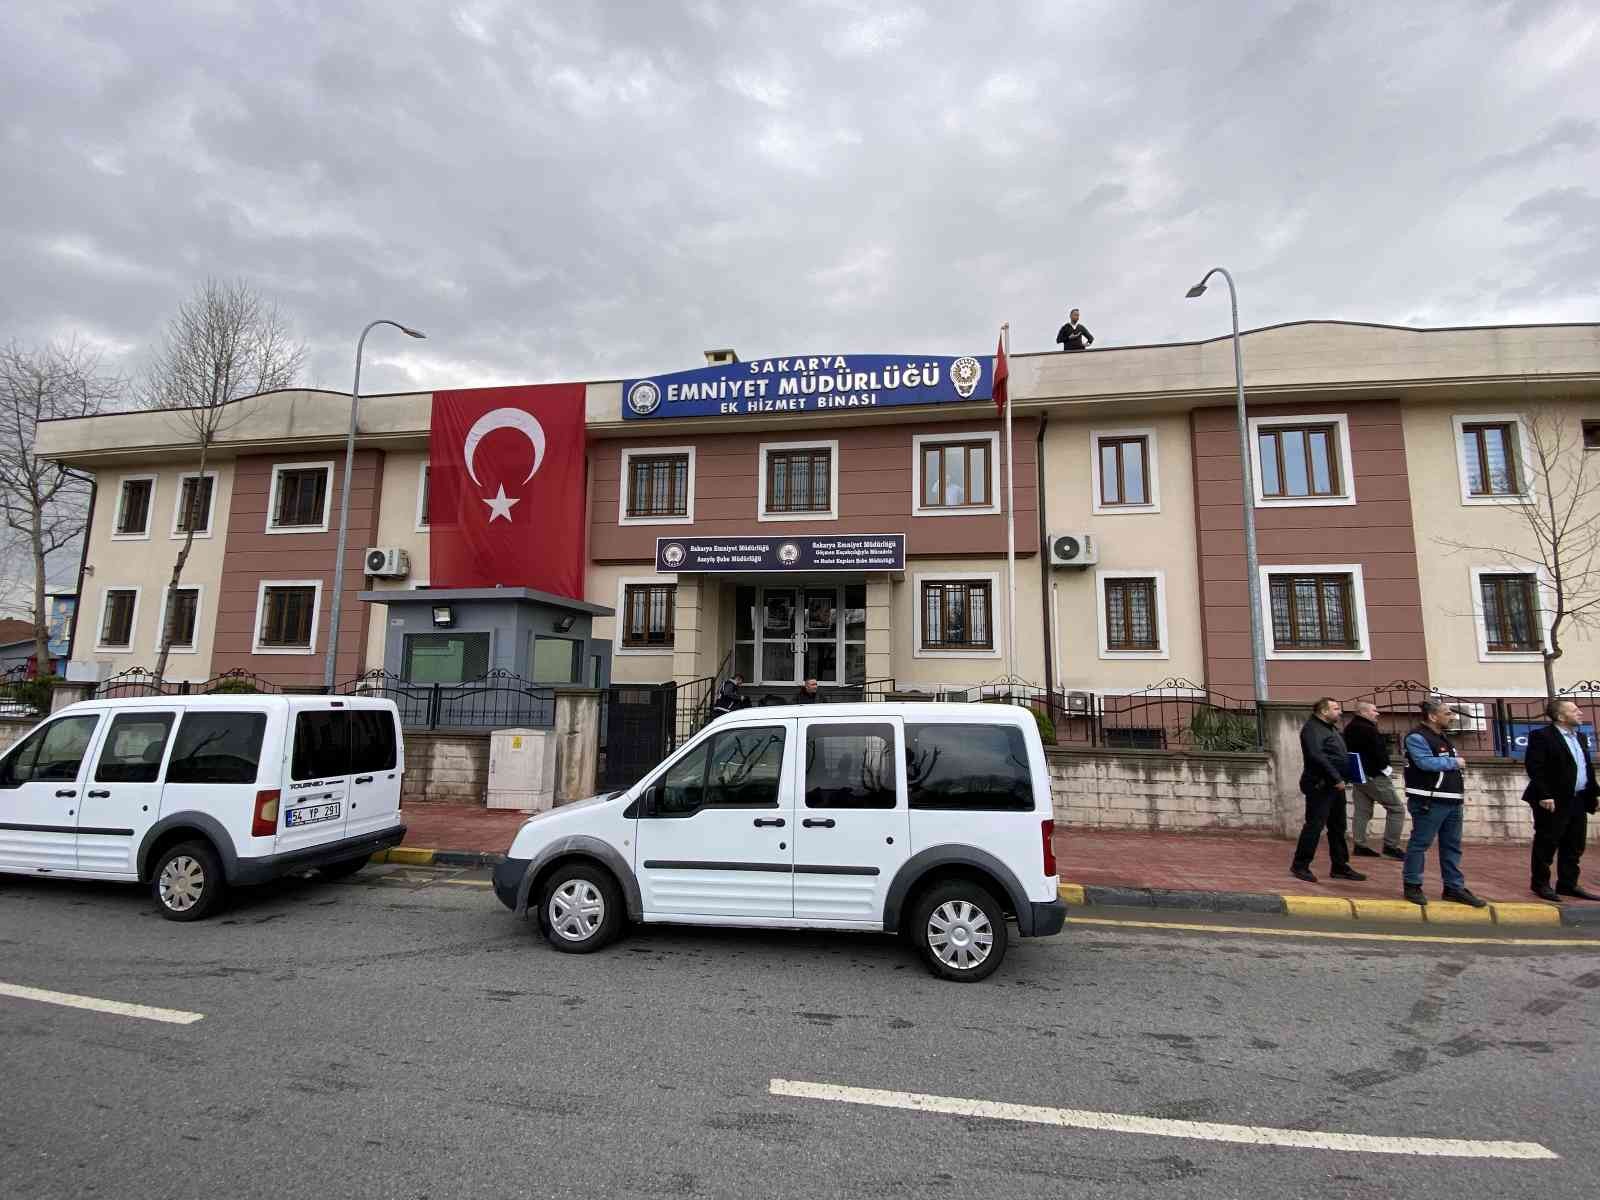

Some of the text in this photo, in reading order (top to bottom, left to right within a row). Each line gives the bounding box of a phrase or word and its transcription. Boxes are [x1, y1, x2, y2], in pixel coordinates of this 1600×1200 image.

[750, 356, 847, 374] SAKARYA
[667, 362, 940, 401] EMNİYET MÜDÜRLÜĞÜ
[720, 393, 877, 414] EK HİZMET BİNASI
[293, 805, 338, 821] 54 YP 291
